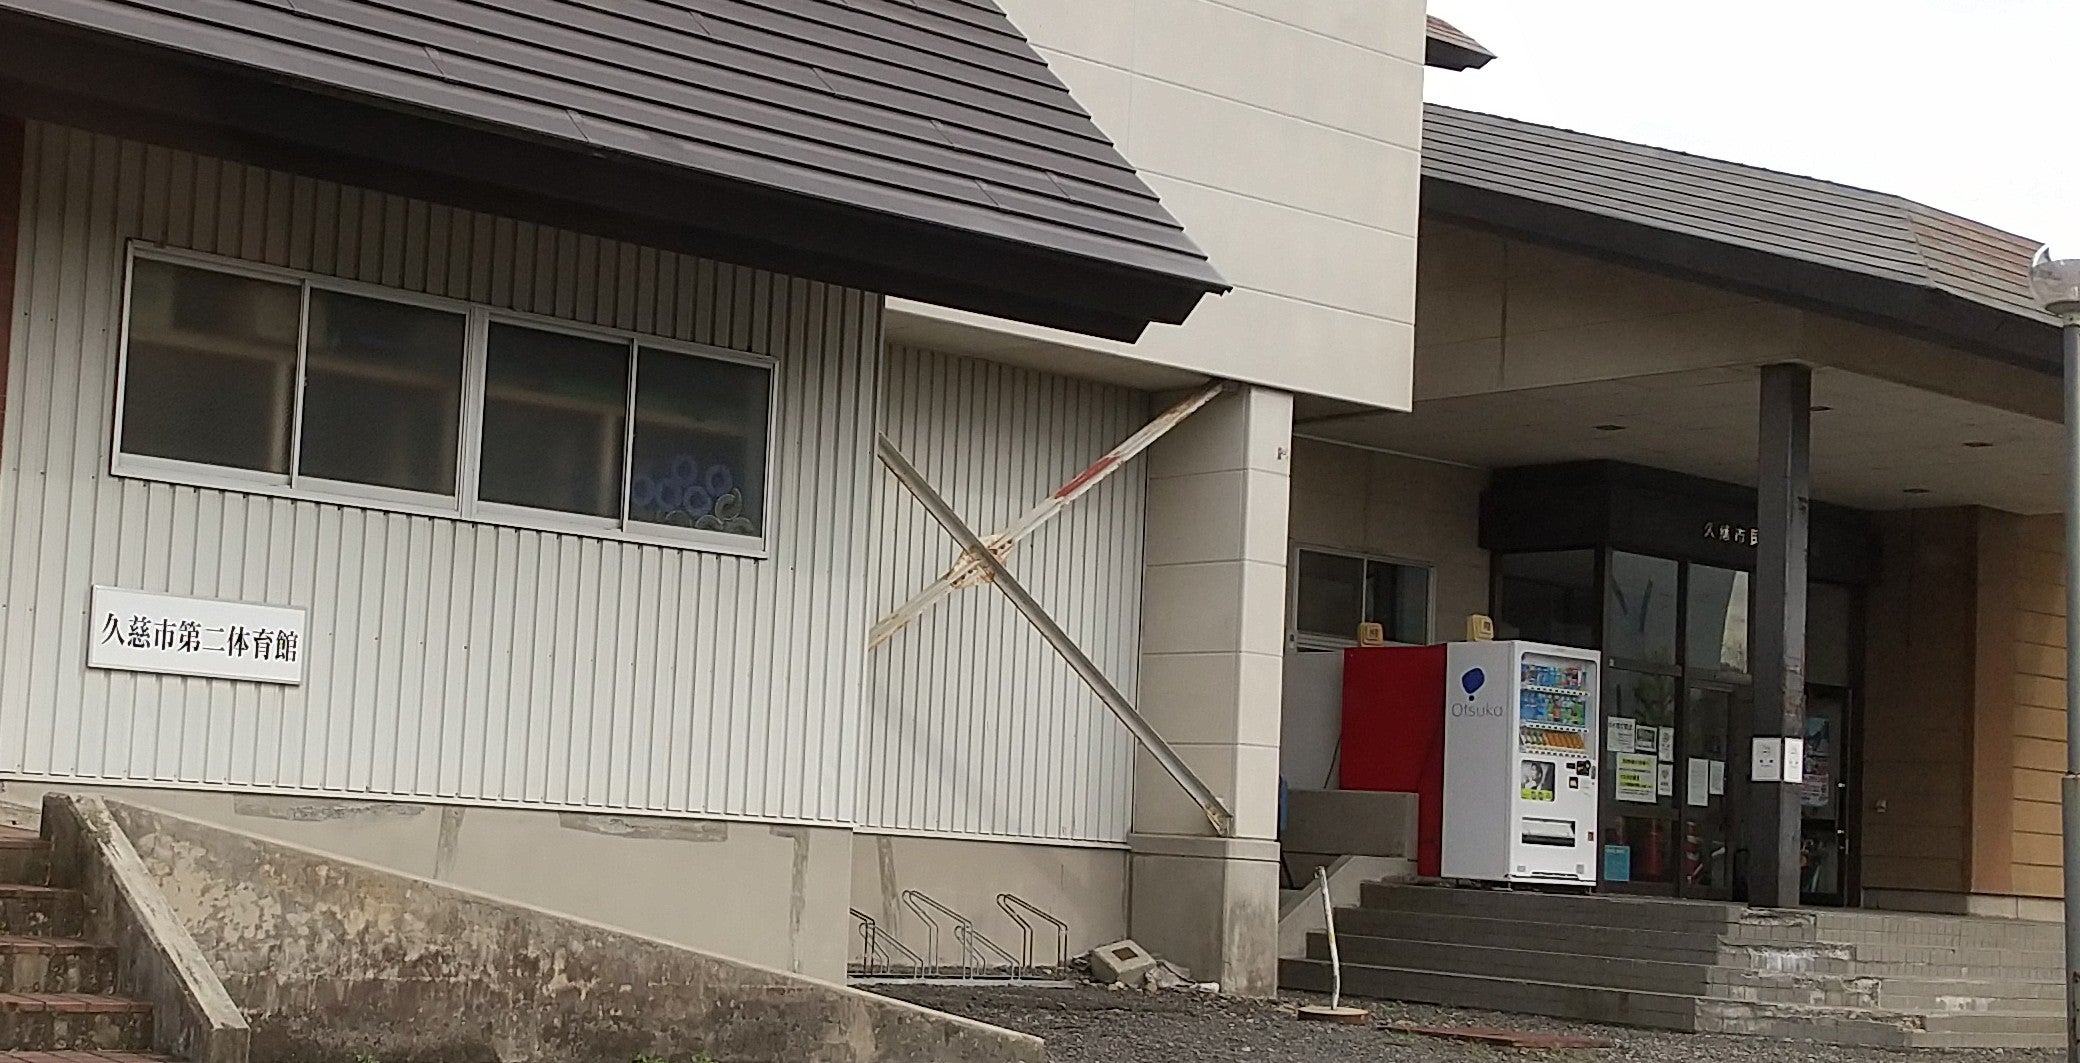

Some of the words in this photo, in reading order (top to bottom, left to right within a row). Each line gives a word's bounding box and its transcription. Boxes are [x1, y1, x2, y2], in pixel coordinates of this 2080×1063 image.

[101, 612, 299, 662] 久慈市第二体育館
[1451, 702, 1503, 717] Otsuka
